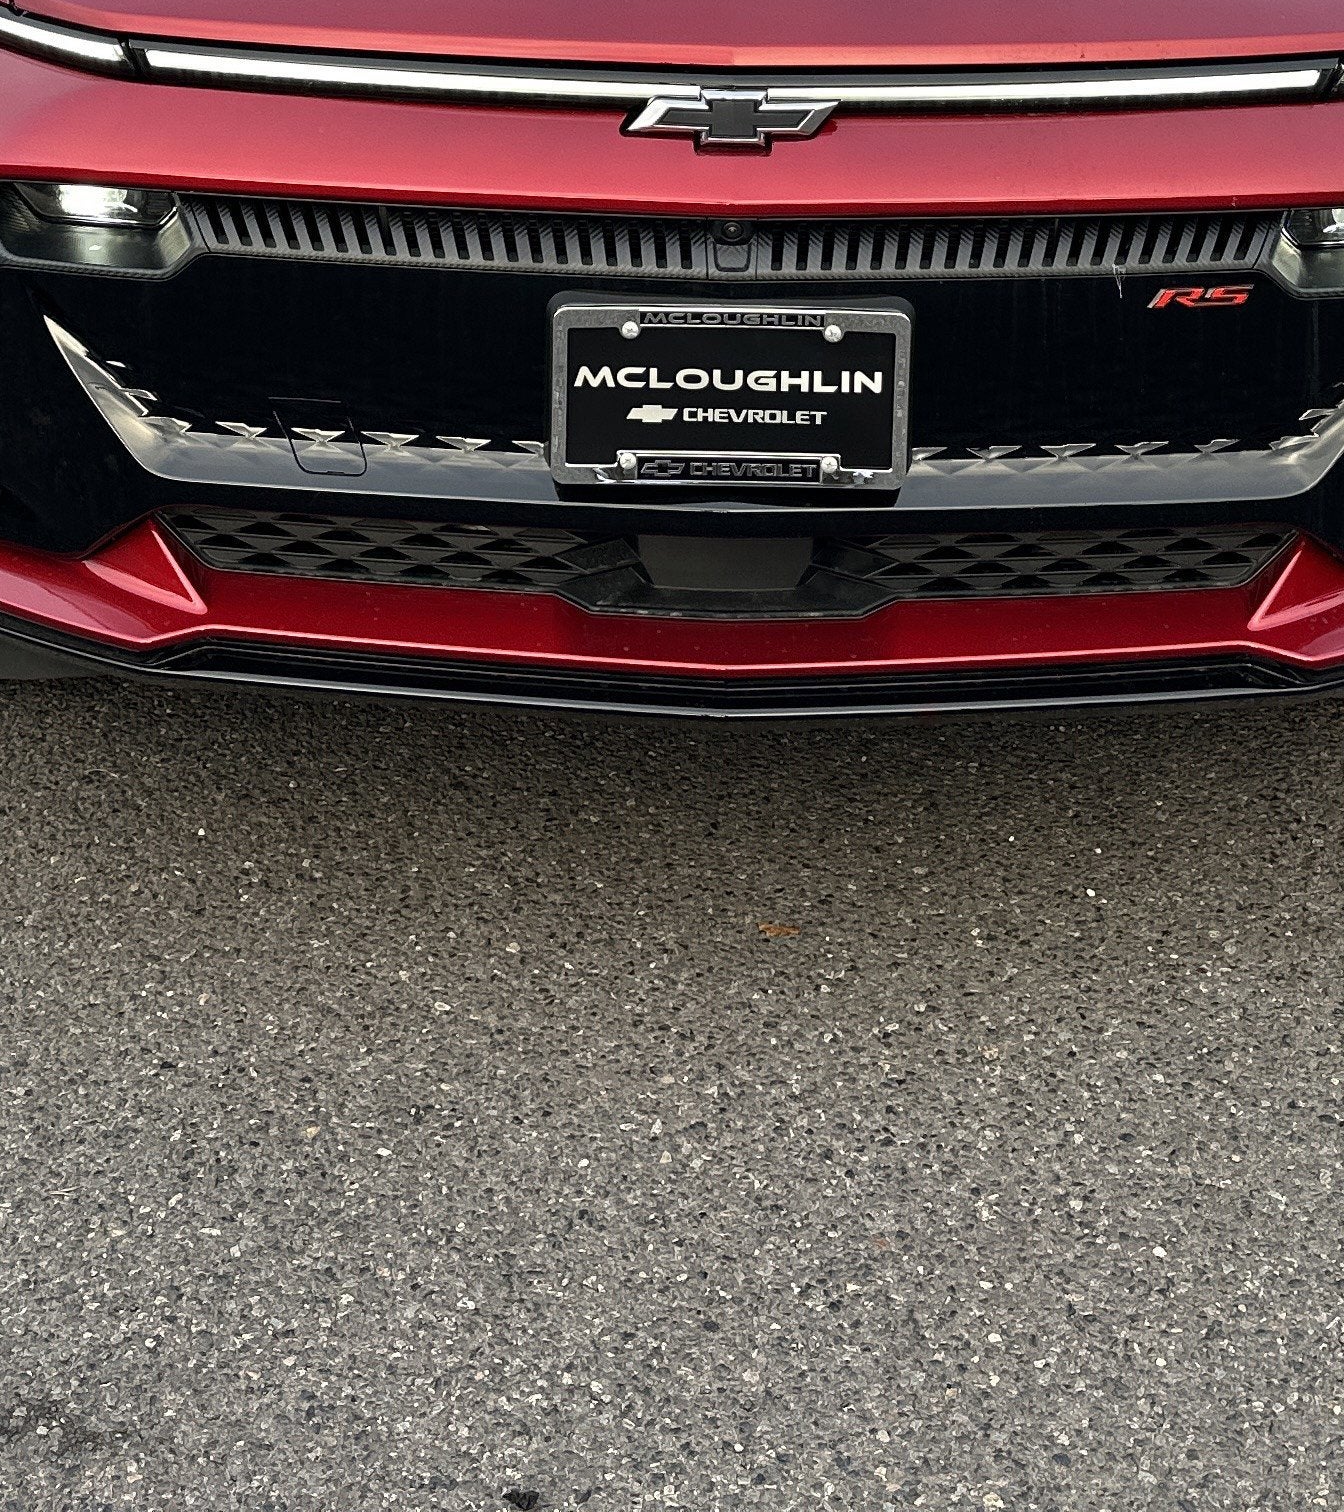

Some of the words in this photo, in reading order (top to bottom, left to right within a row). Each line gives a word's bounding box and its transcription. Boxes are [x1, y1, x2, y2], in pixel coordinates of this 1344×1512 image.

[1146, 284, 1255, 309] RS
[643, 311, 823, 328] MCLOUGHLIN
[573, 365, 883, 394] MCLOUGHLIN
[682, 407, 828, 425] CHEVROLET
[689, 461, 818, 478] CHEVROLET
